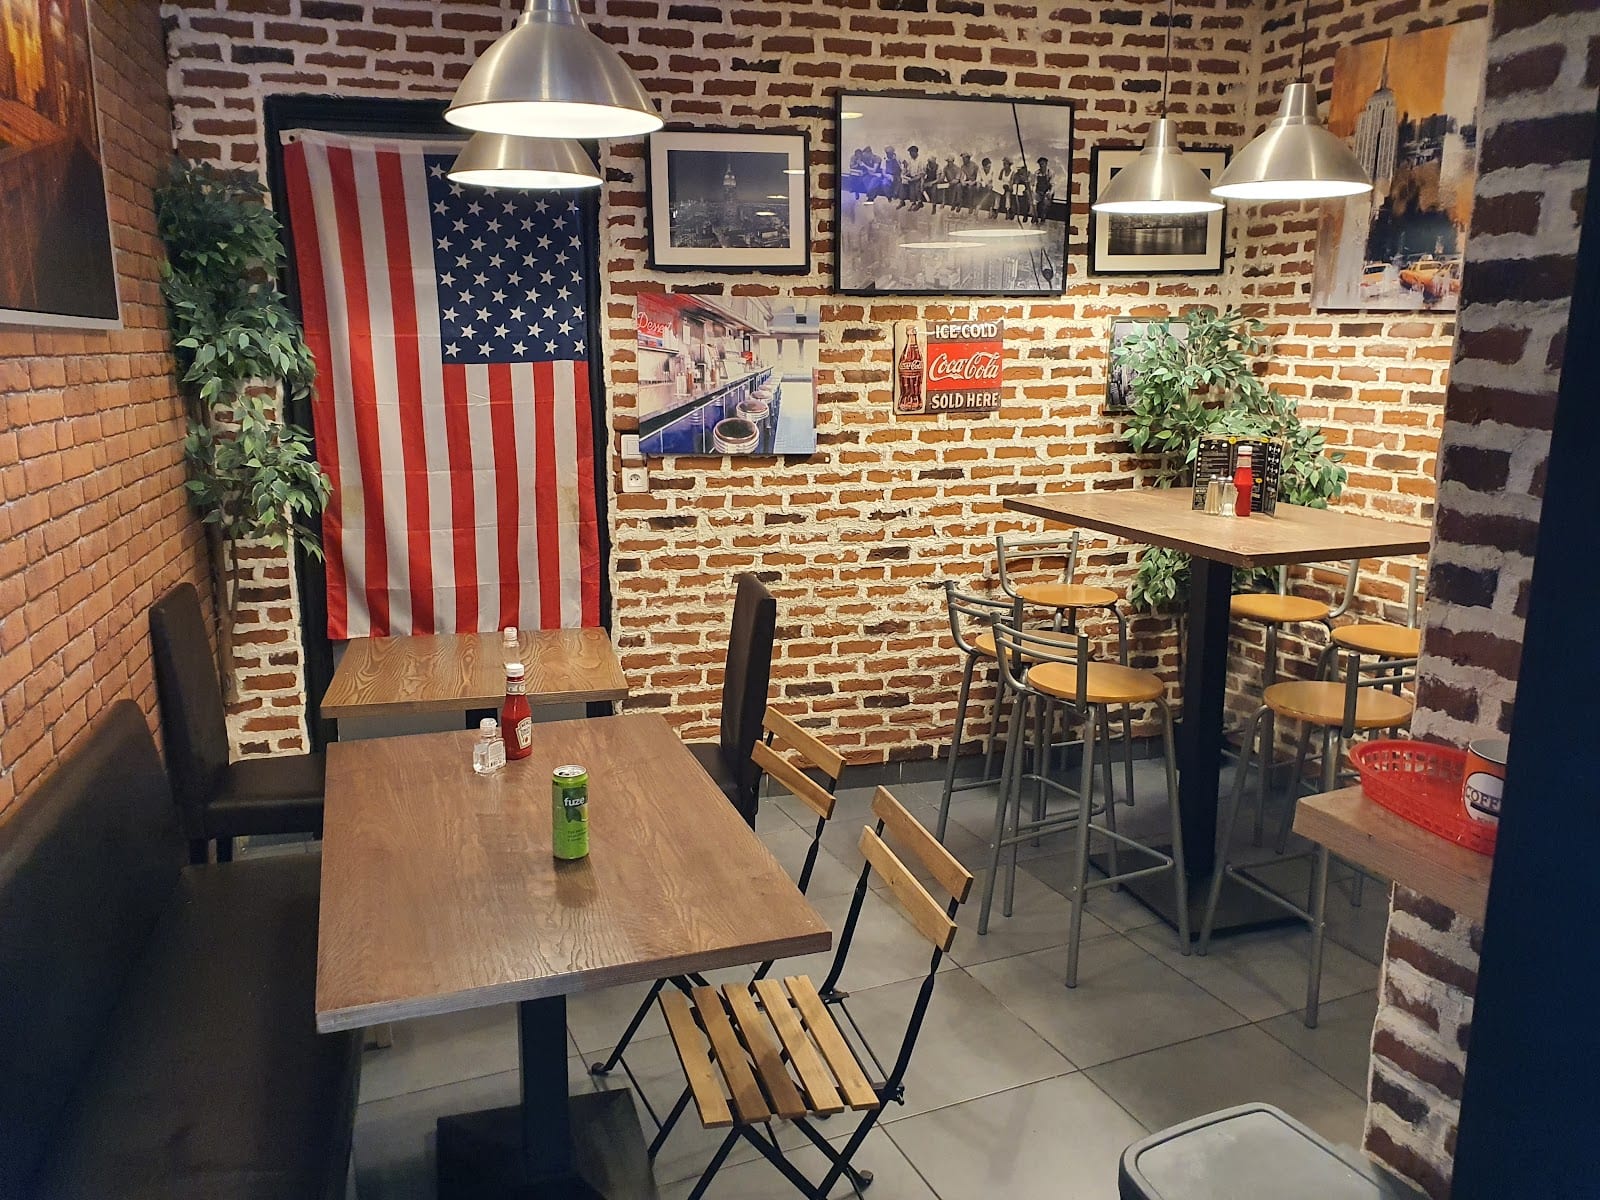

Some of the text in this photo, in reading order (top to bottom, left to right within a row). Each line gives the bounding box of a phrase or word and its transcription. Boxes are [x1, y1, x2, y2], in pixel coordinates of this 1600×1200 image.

[935, 323, 998, 339] ICE COLD
[928, 351, 1000, 381] Coca-Cola
[931, 391, 998, 409] SOLD HERE
[564, 797, 585, 807] fuze
[1465, 786, 1501, 810] COFF
